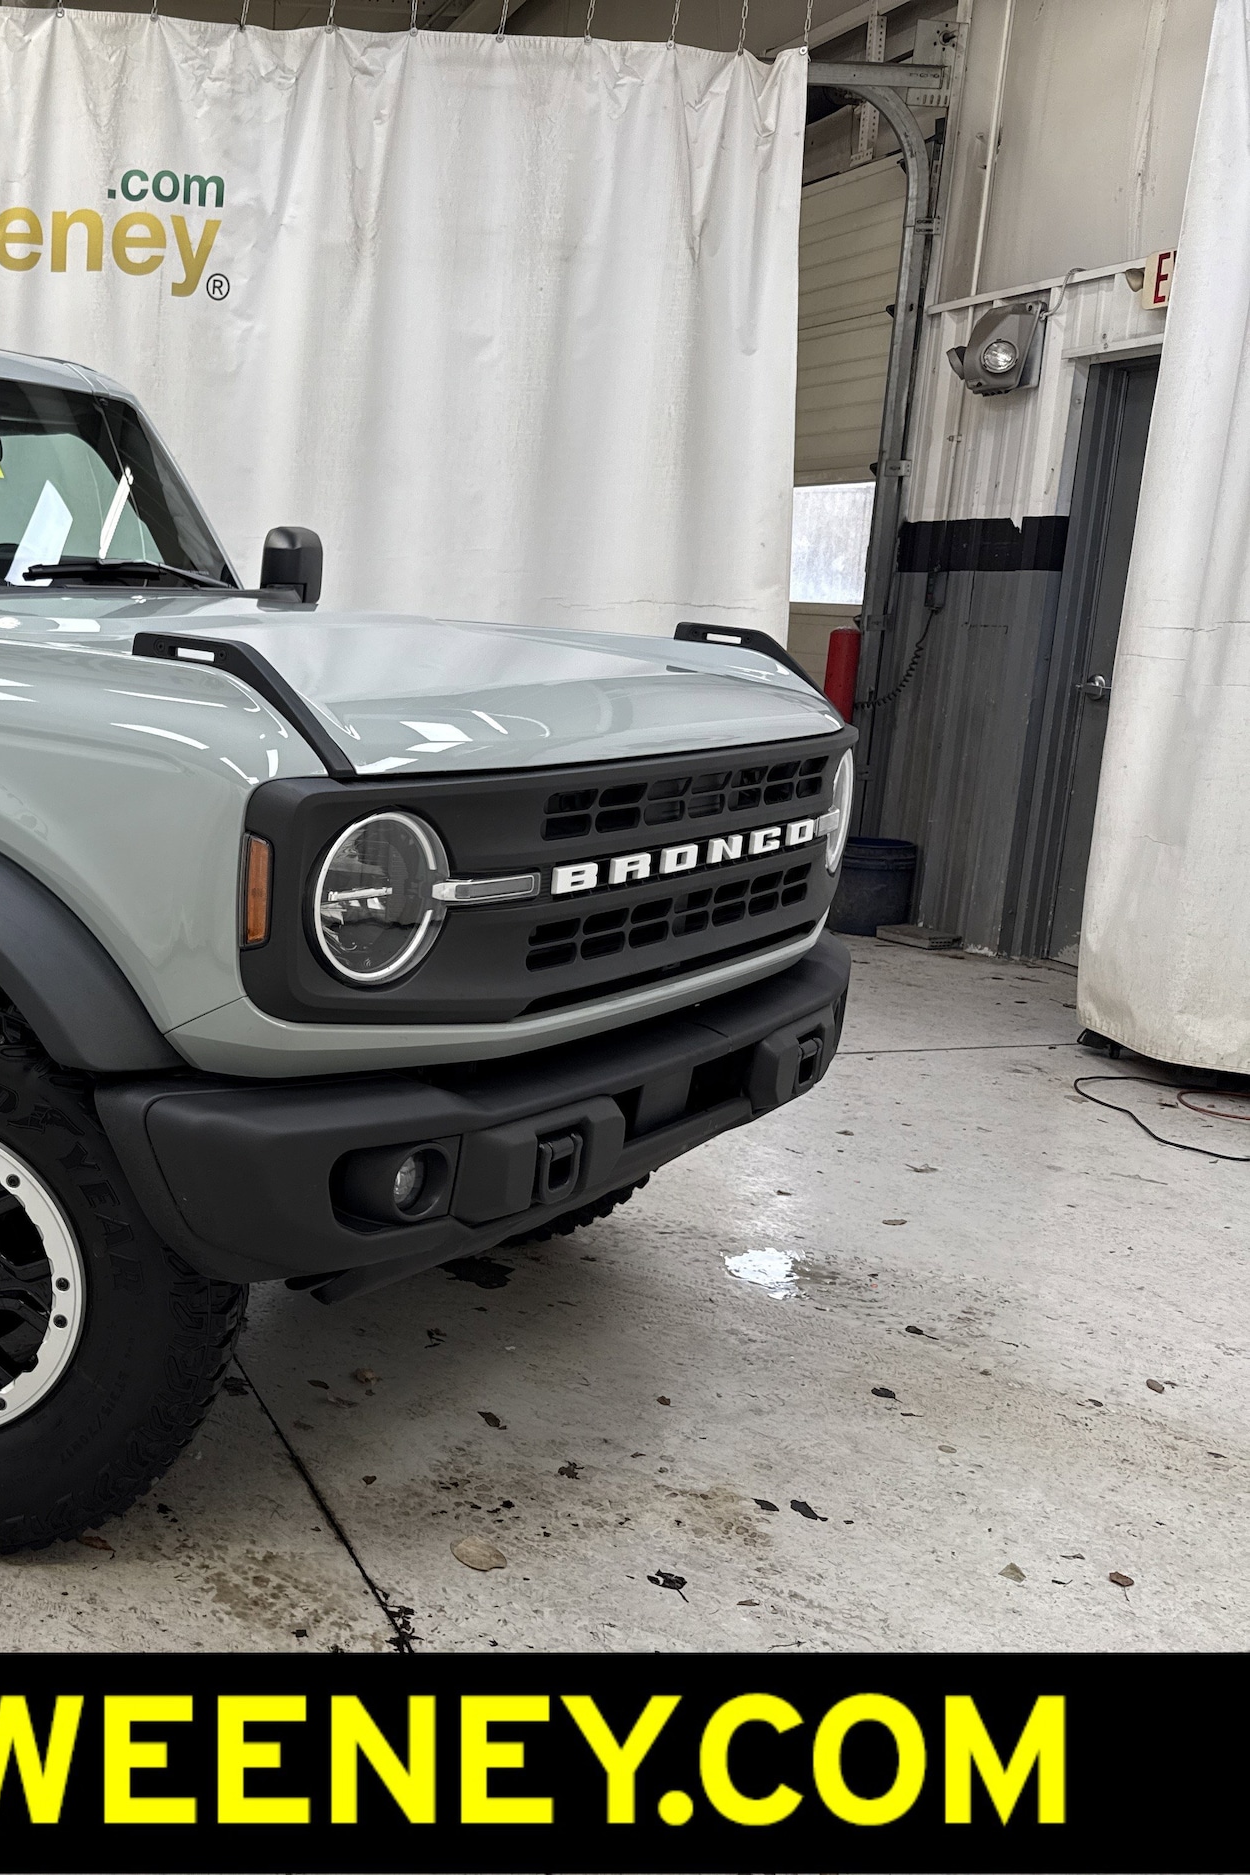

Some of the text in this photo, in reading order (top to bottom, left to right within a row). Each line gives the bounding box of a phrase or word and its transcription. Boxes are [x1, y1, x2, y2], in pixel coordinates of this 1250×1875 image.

[107, 168, 225, 208] .com
[1153, 250, 1178, 304] E
[550, 818, 815, 895] BRONCO
